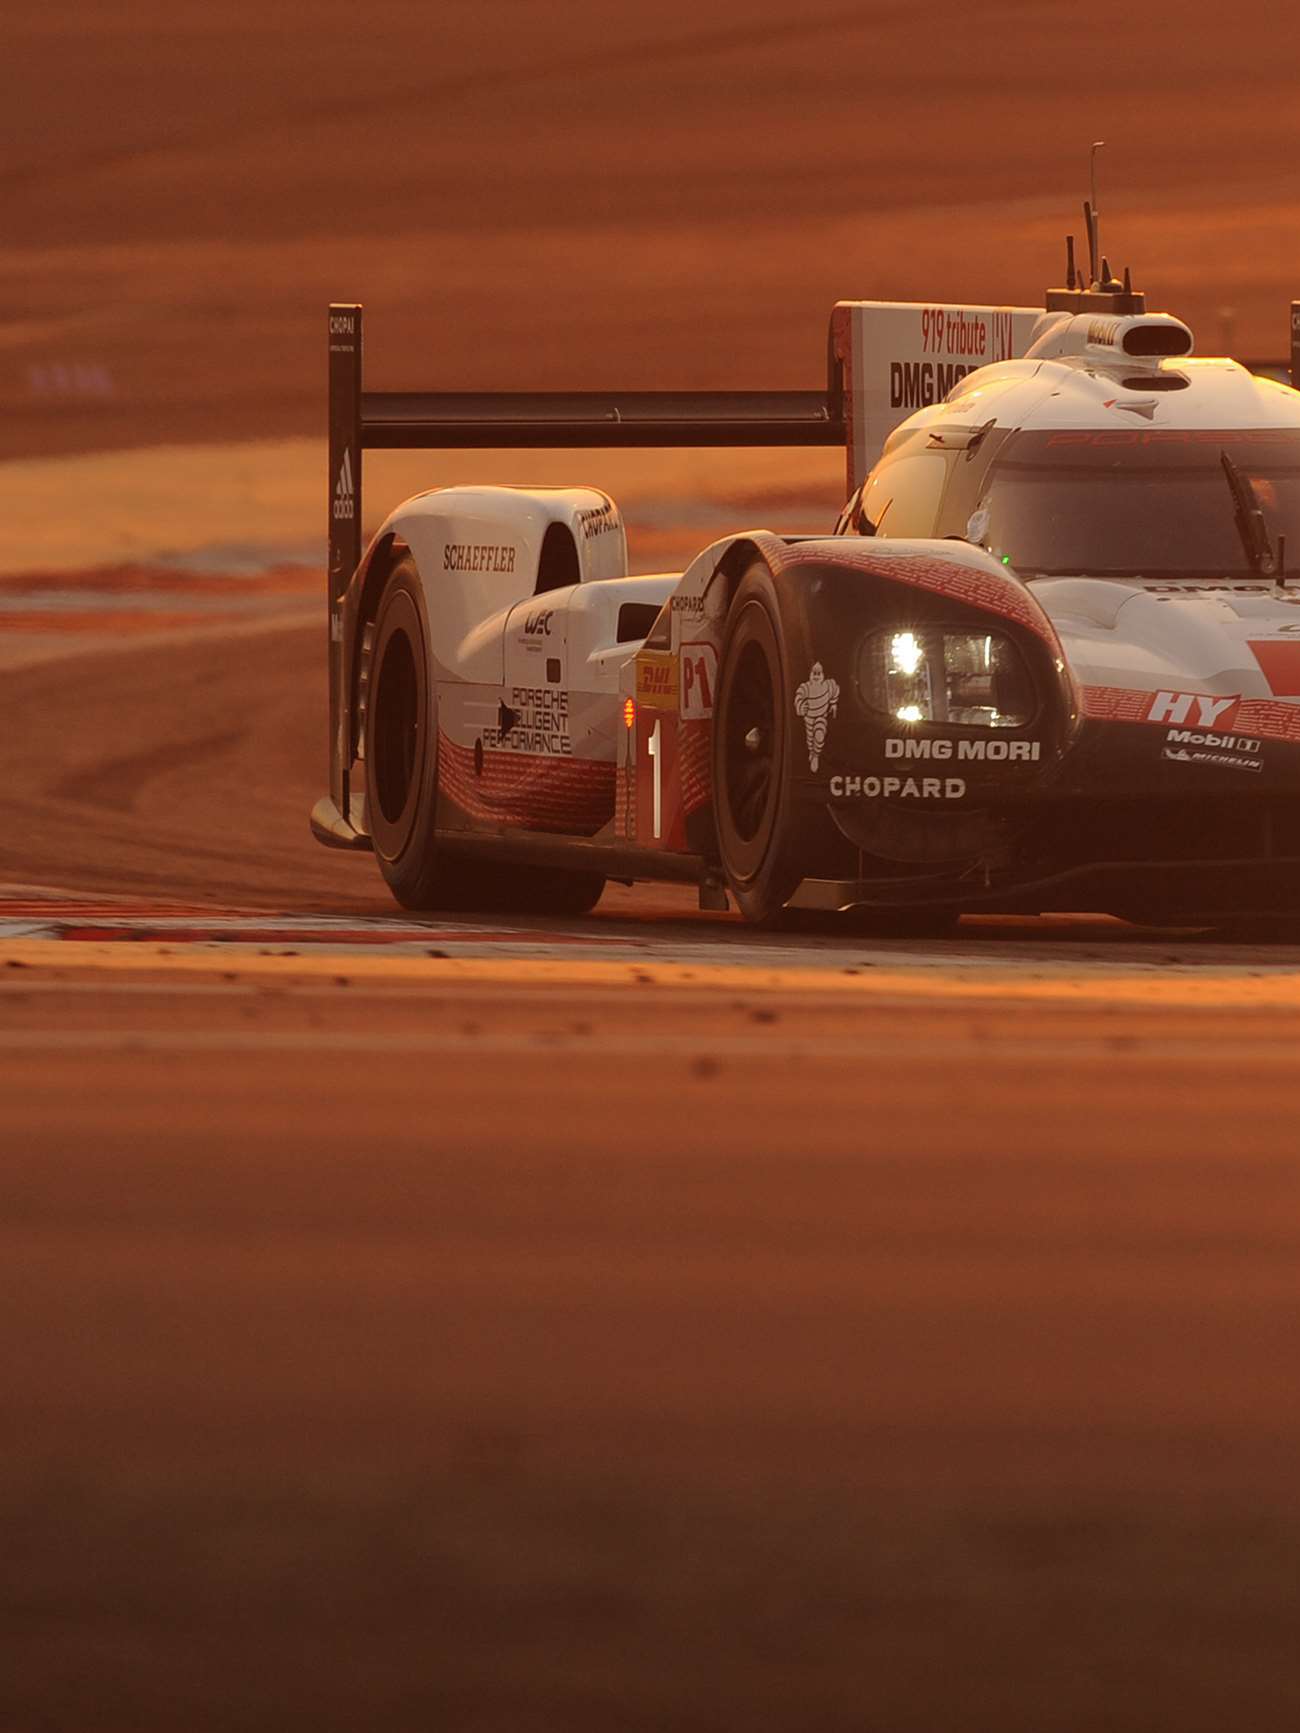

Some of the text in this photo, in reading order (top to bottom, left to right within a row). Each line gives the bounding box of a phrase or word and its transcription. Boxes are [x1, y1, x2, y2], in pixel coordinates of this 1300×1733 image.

[922, 309, 944, 353] 919
[946, 310, 986, 356] tribute
[890, 362, 933, 408] DMG
[443, 544, 516, 573] SCHAEFFLER
[683, 656, 713, 709] P1
[512, 687, 569, 710] PORSCHE
[1147, 691, 1237, 728] HY
[884, 738, 1041, 761] DMG MORI
[1166, 729, 1236, 749] Mobil
[1190, 751, 1261, 769] MICHELIN
[648, 719, 661, 839] 1
[829, 775, 967, 799] CHOPARD
